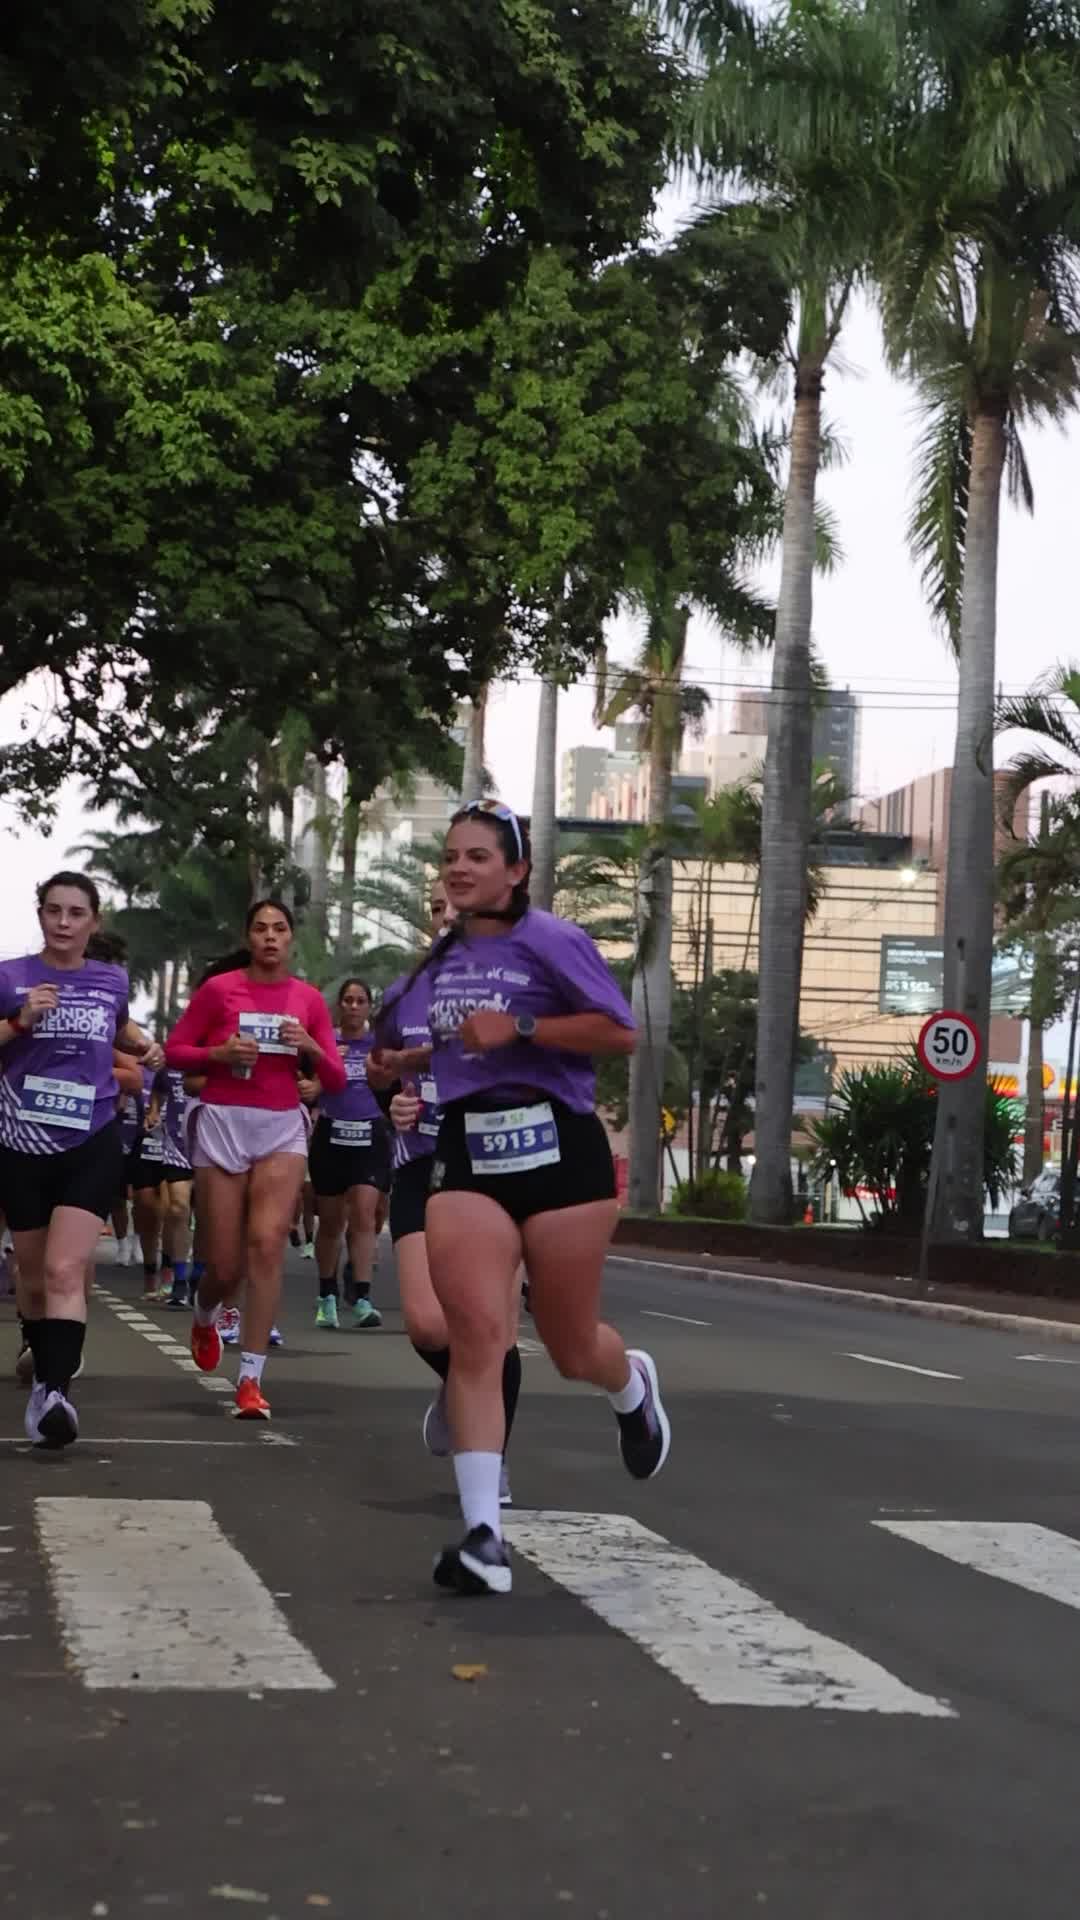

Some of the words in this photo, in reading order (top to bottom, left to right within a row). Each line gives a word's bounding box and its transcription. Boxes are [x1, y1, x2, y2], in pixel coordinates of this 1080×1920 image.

[254, 1027, 280, 1040] 512
[932, 1026, 968, 1056] 50
[35, 1093, 77, 1111] 6336
[482, 1128, 537, 1152] 5913
